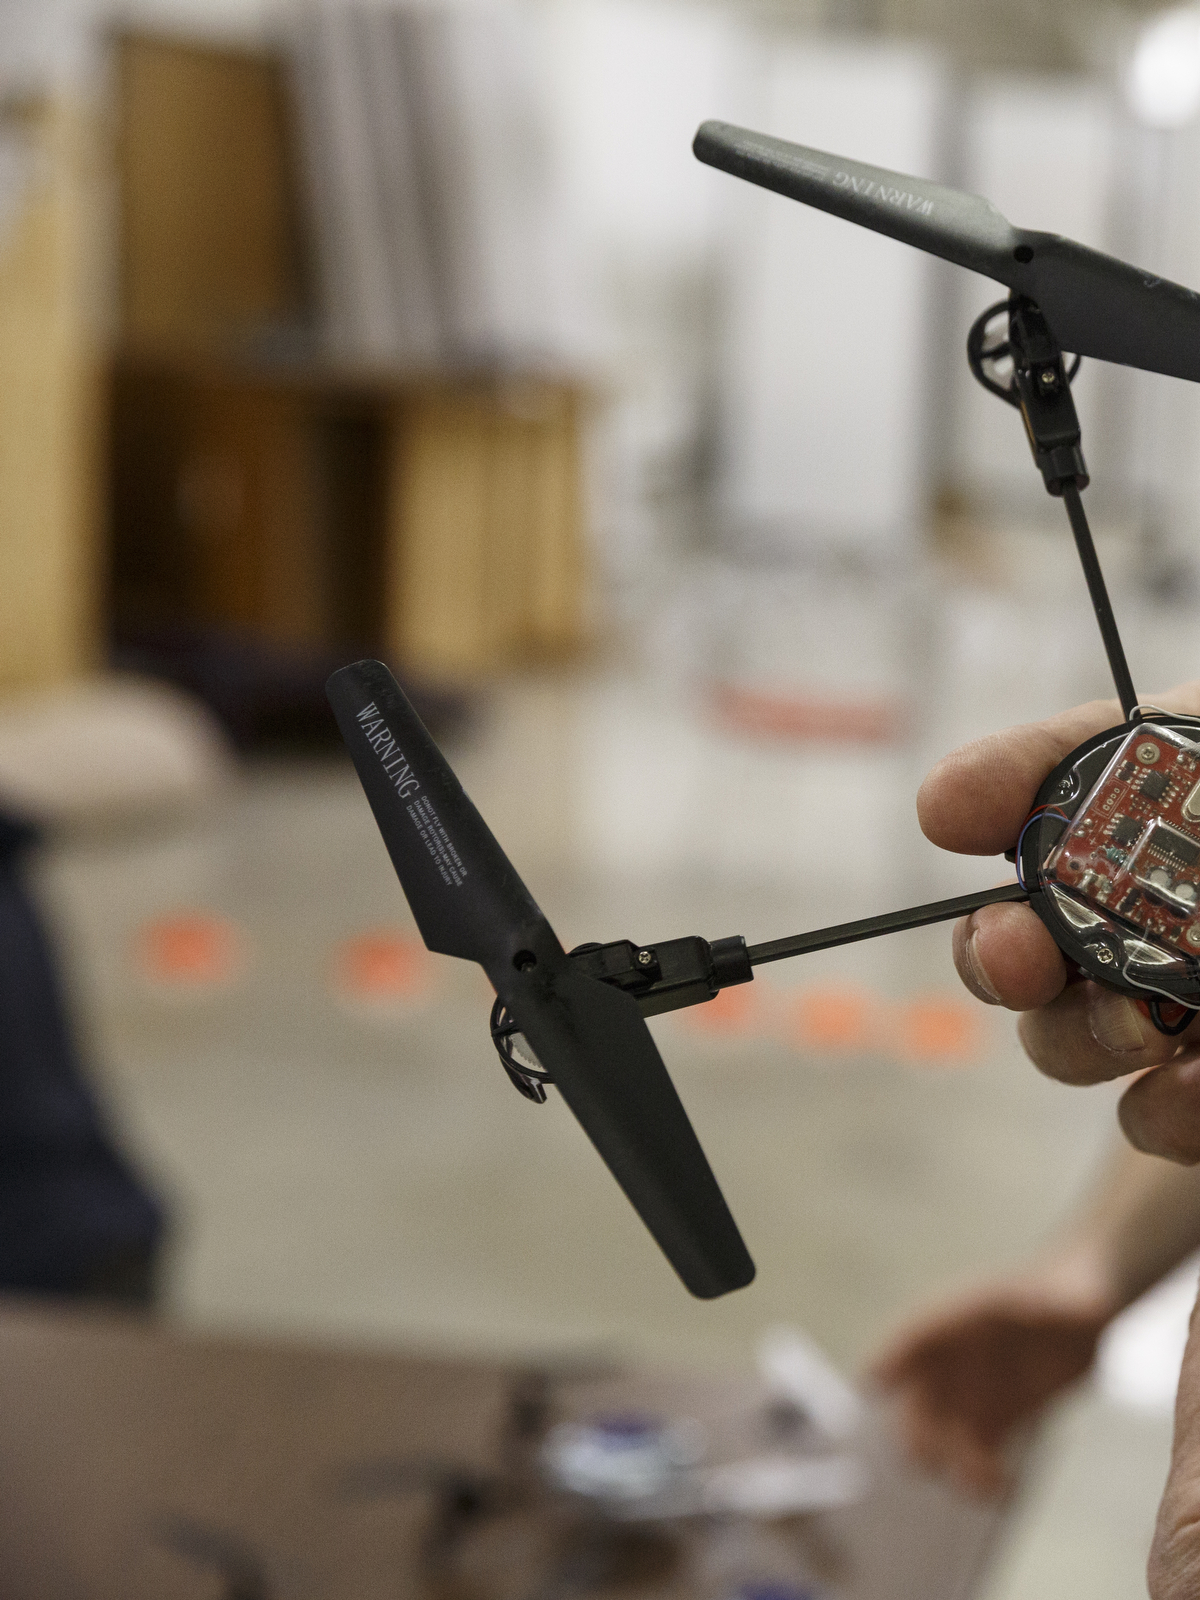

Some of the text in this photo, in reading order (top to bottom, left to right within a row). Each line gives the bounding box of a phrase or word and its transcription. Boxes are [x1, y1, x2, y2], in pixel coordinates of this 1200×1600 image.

[832, 171, 935, 216] WARNING
[356, 701, 420, 799] WARNING
[406, 804, 452, 886] DAMAGE OR LEAD TO INJURY
[414, 800, 430, 826] DAMAGE
[449, 866, 463, 887] CAUSE
[421, 795, 468, 877] DONOT FLY WITH BROKEN OR
